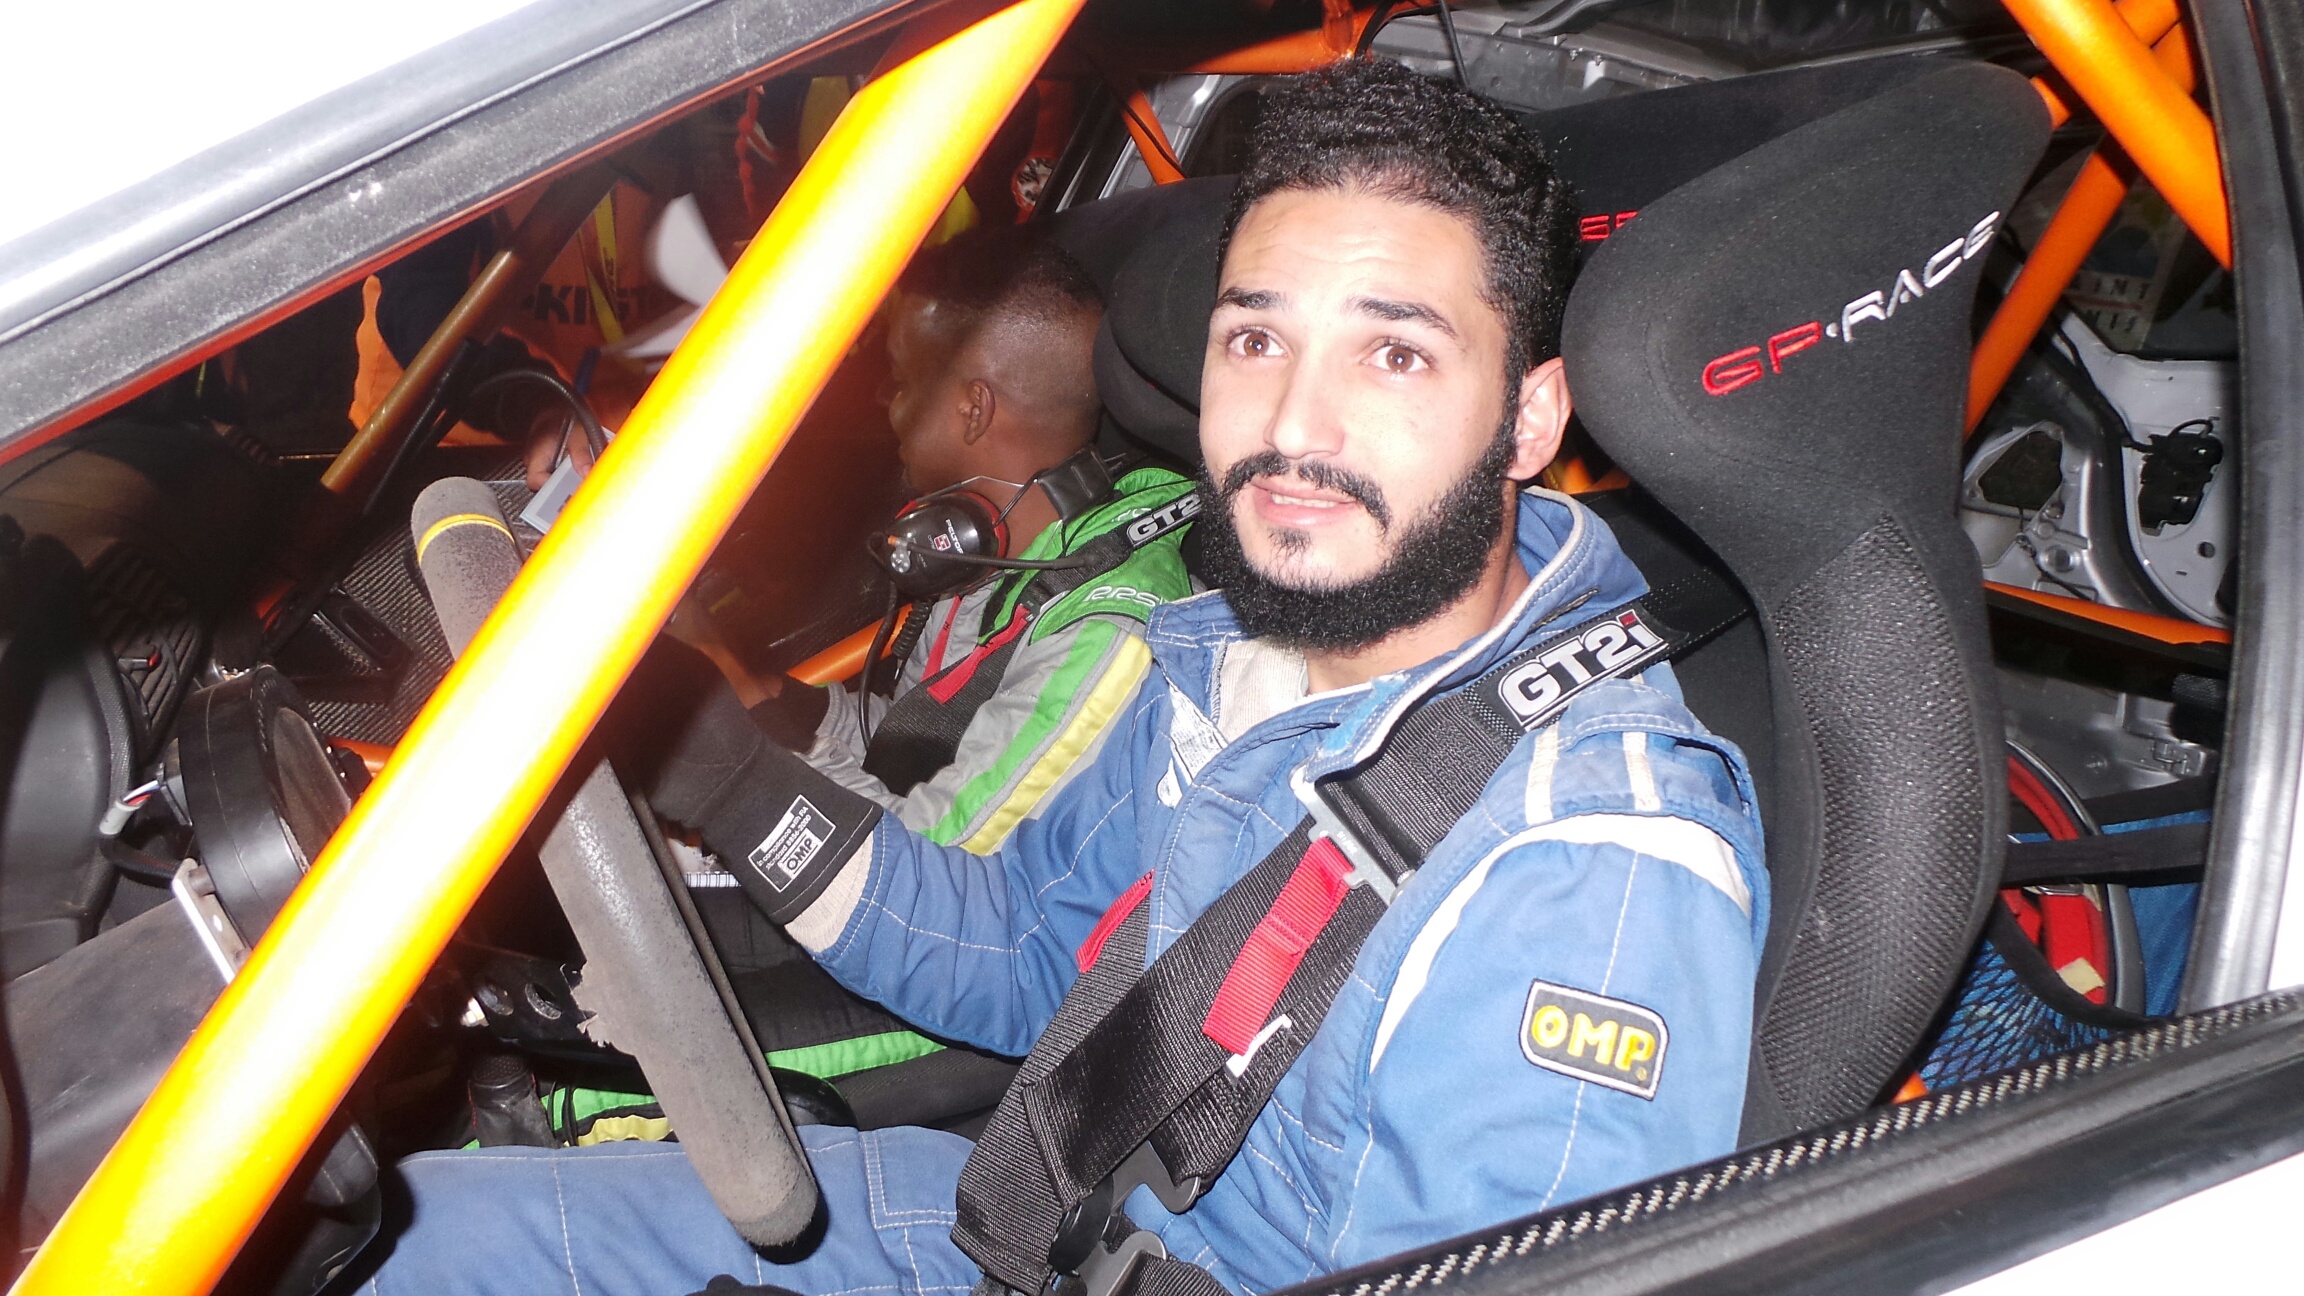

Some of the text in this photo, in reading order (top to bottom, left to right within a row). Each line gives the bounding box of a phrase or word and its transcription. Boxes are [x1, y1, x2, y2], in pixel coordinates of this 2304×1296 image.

[1127, 494, 1202, 545] GT2
[1499, 610, 1663, 720] GT2i
[762, 828, 792, 861] compliance
[790, 816, 801, 829] with
[799, 806, 809, 817] FIA
[765, 845, 787, 870] standard
[787, 838, 812, 870] OMP
[1531, 1005, 1656, 1071] OMP
